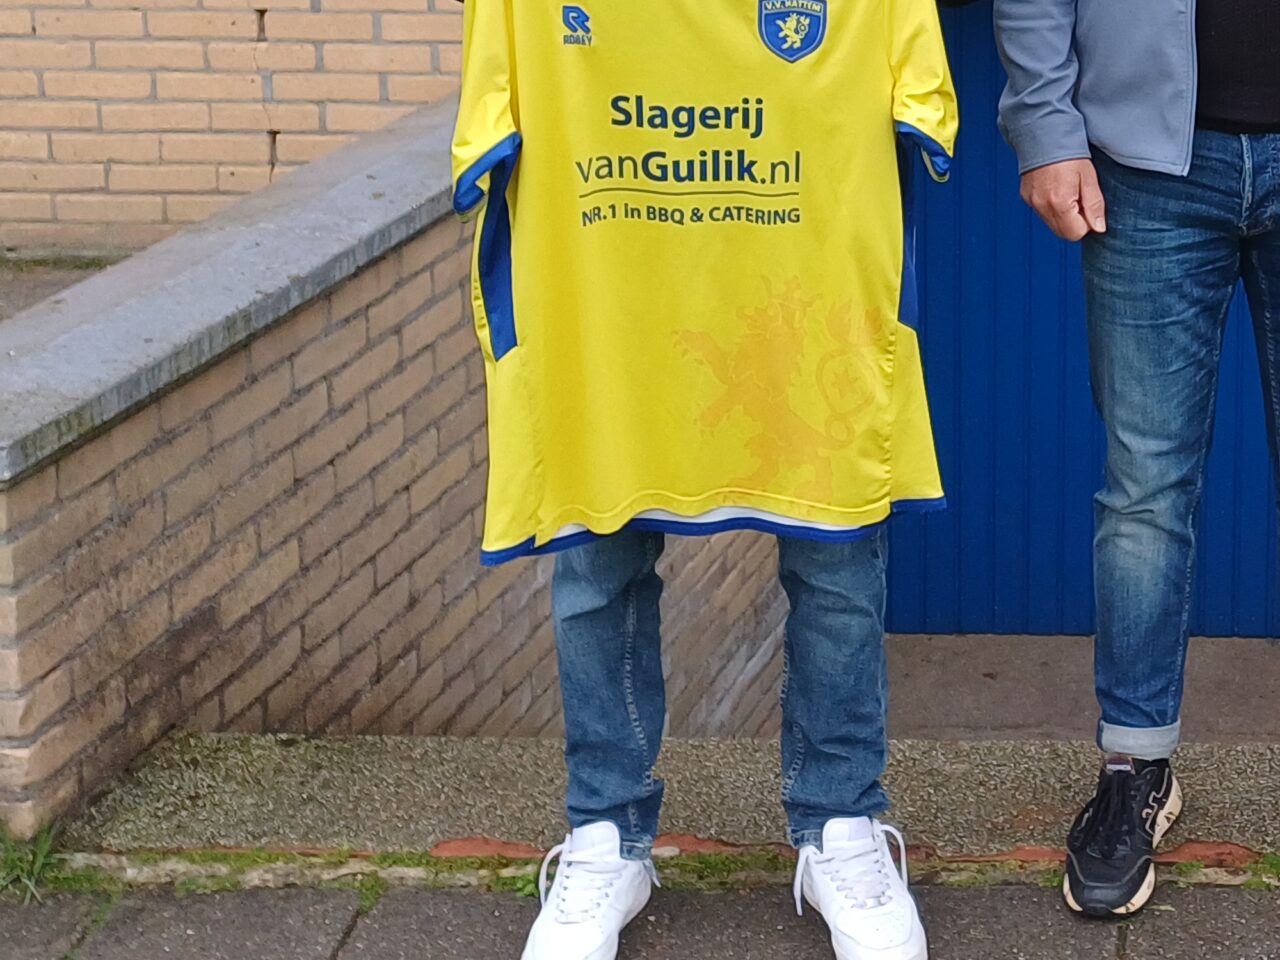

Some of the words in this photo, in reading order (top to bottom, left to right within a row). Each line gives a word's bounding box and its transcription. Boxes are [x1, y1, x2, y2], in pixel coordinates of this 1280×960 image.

[610, 94, 764, 139] Slagerij
[575, 149, 800, 184] vanGuilik.nl
[581, 203, 617, 227] NR.1
[646, 205, 685, 226] BBQ
[689, 207, 705, 223] &
[708, 205, 801, 226] CATERING
